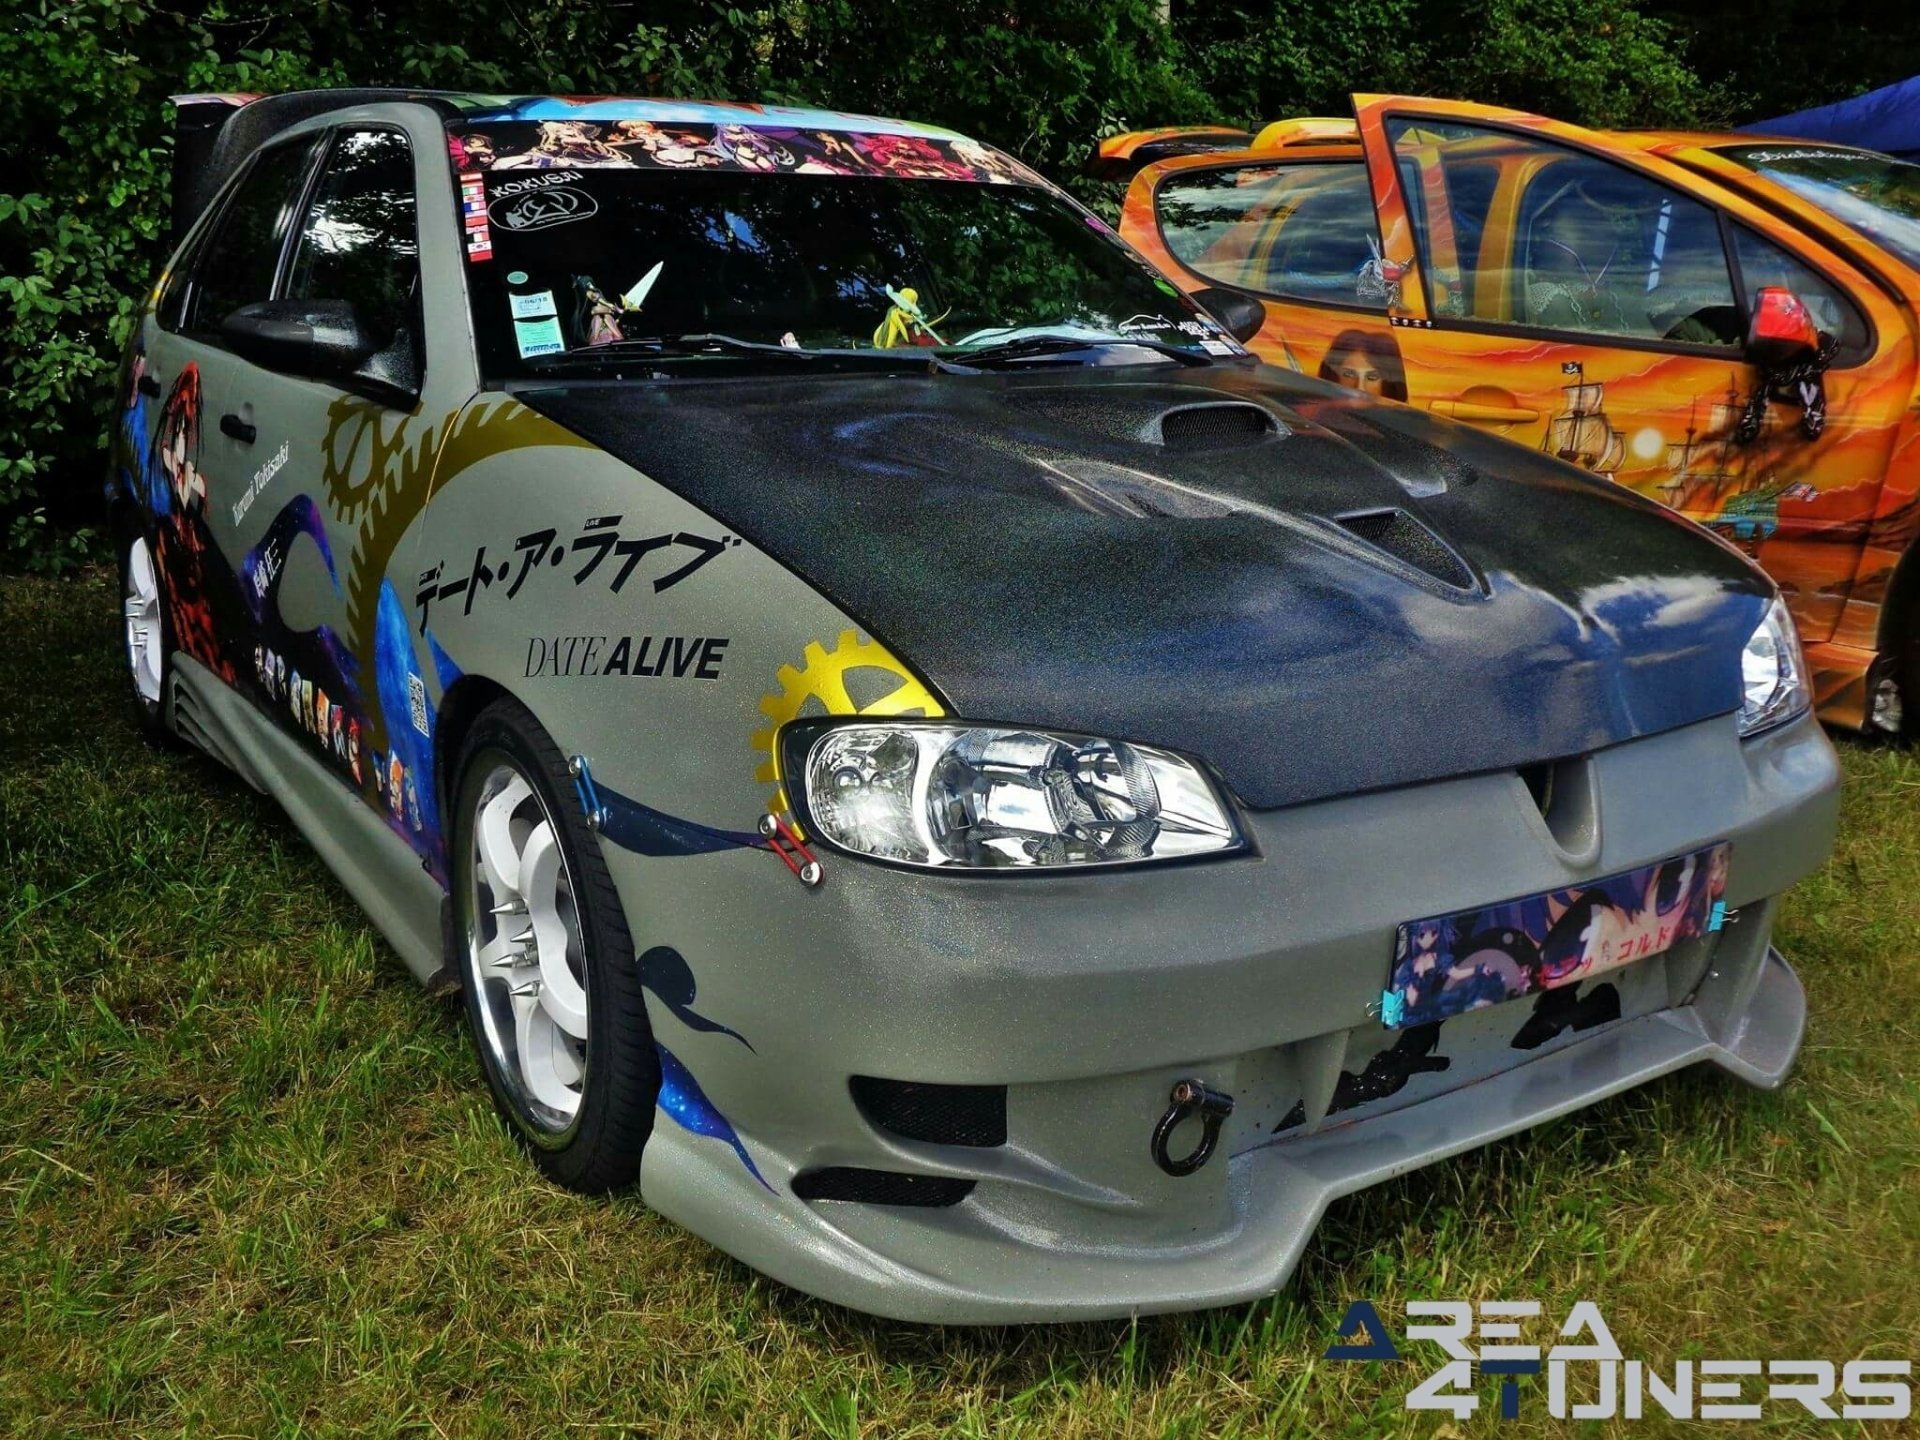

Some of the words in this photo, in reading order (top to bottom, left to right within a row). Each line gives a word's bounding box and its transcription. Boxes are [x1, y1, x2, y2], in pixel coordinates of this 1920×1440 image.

[488, 170, 584, 197] KOKUSAI
[415, 514, 743, 639] デート・ア・ライブ
